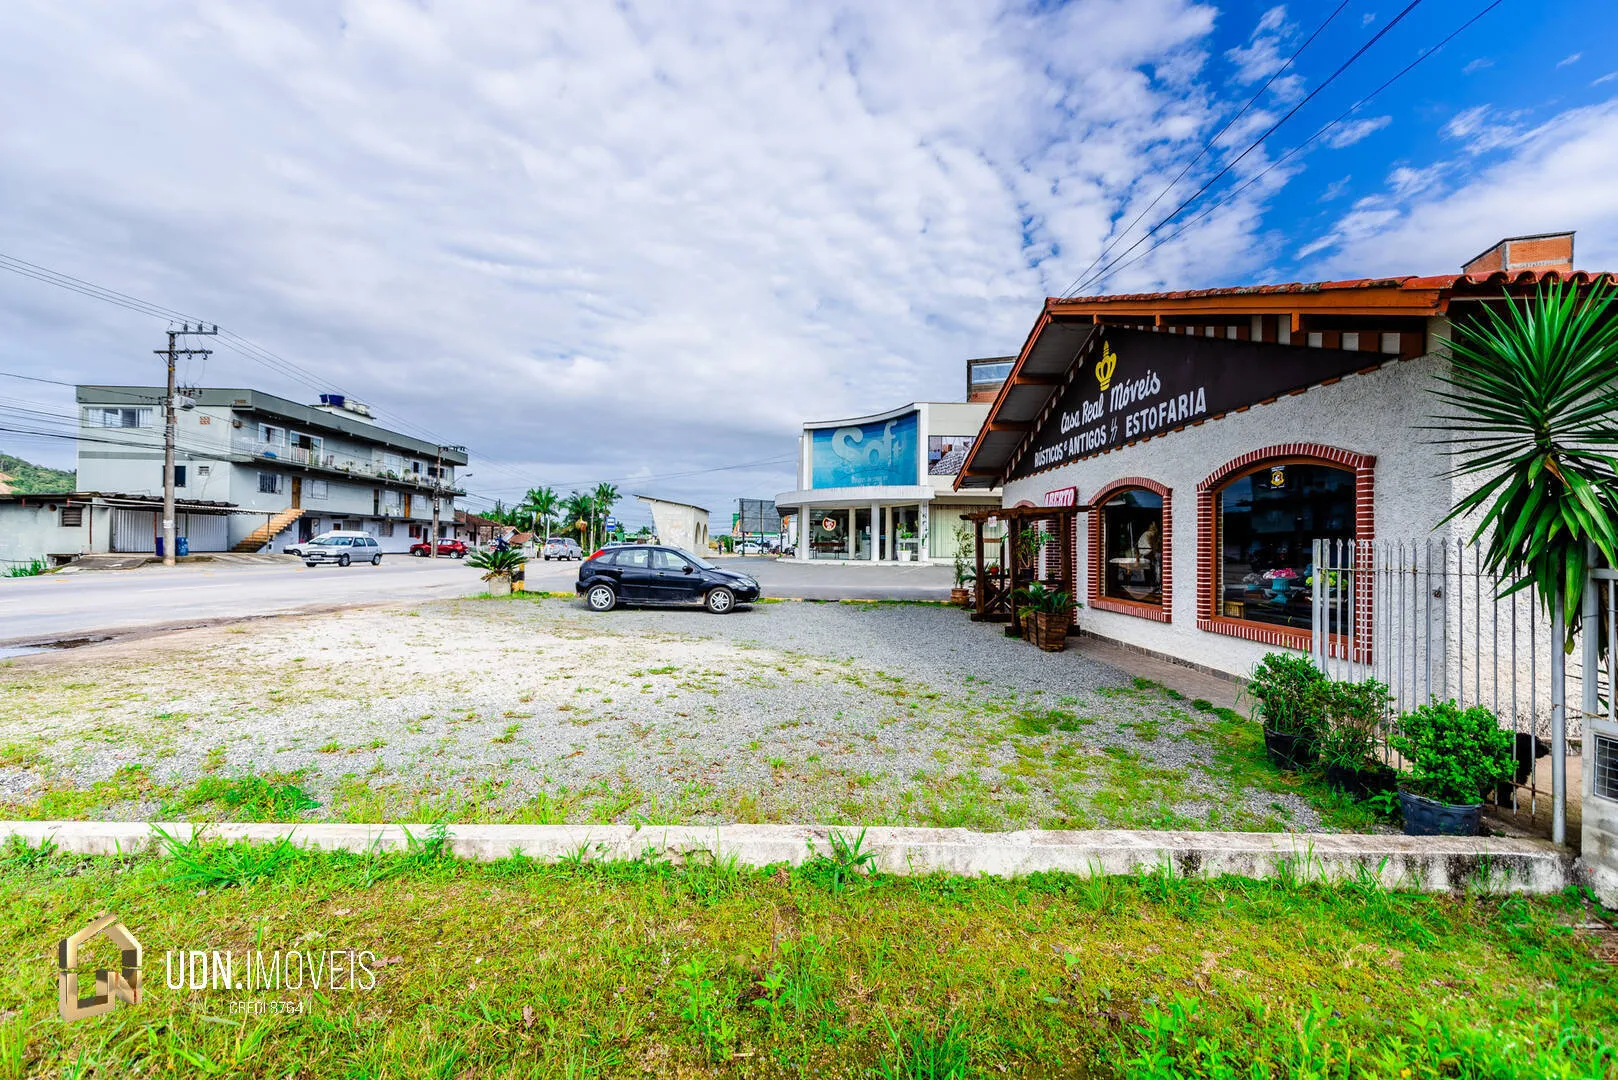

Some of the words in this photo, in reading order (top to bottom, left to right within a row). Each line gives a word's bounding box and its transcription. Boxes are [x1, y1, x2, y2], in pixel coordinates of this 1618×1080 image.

[1061, 411, 1080, 434] Casa
[1082, 392, 1104, 425] Real
[1109, 369, 1161, 413] Móveis
[1125, 387, 1207, 437] ESTOFARIA
[1034, 442, 1063, 468] RÚSTICOS
[1068, 425, 1107, 456] ANTIGOS
